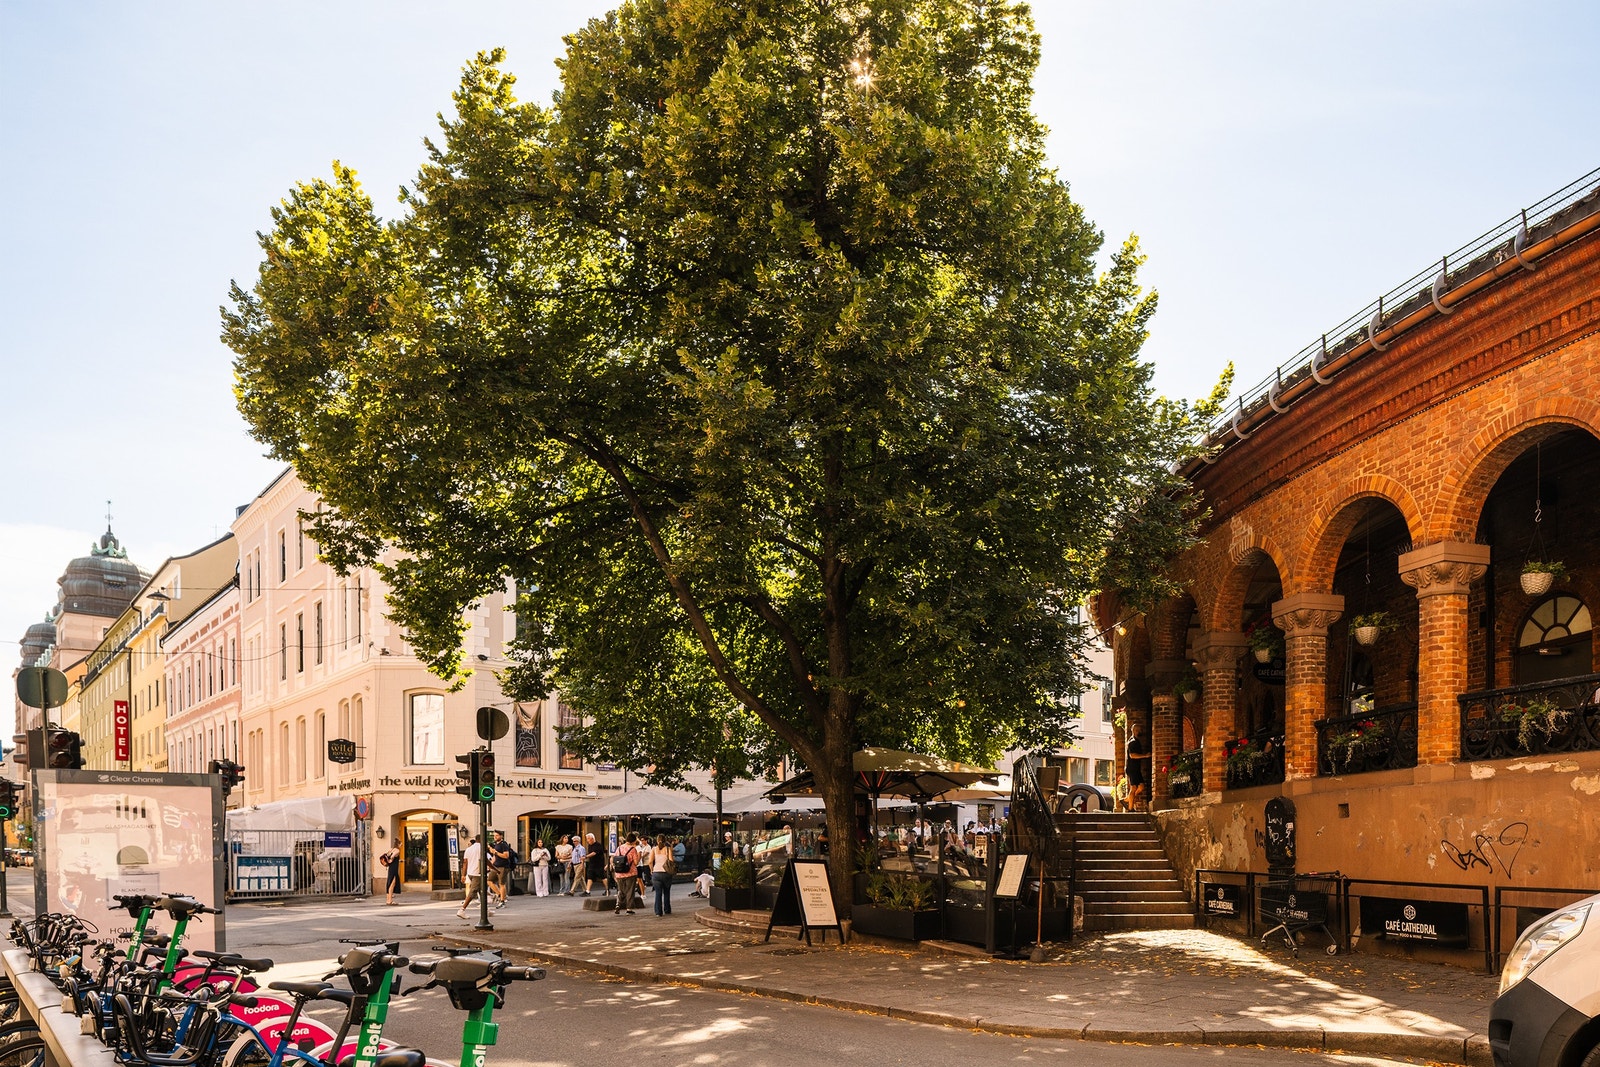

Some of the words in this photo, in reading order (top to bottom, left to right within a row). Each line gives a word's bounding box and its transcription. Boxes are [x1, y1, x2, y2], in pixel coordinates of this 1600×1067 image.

[116, 705, 127, 757] HOTEL
[331, 744, 353, 752] wild
[405, 776, 431, 786] wild
[495, 776, 514, 788] he
[517, 778, 546, 790] wild
[1385, 919, 1400, 931] CAFÉ
[1401, 922, 1437, 935] CATHEDRAL
[131, 931, 141, 946] Bolt
[244, 1004, 280, 1015] foodora
[270, 1028, 310, 1038] foora
[362, 1023, 383, 1056] Bolt
[472, 1045, 488, 1067] olt
